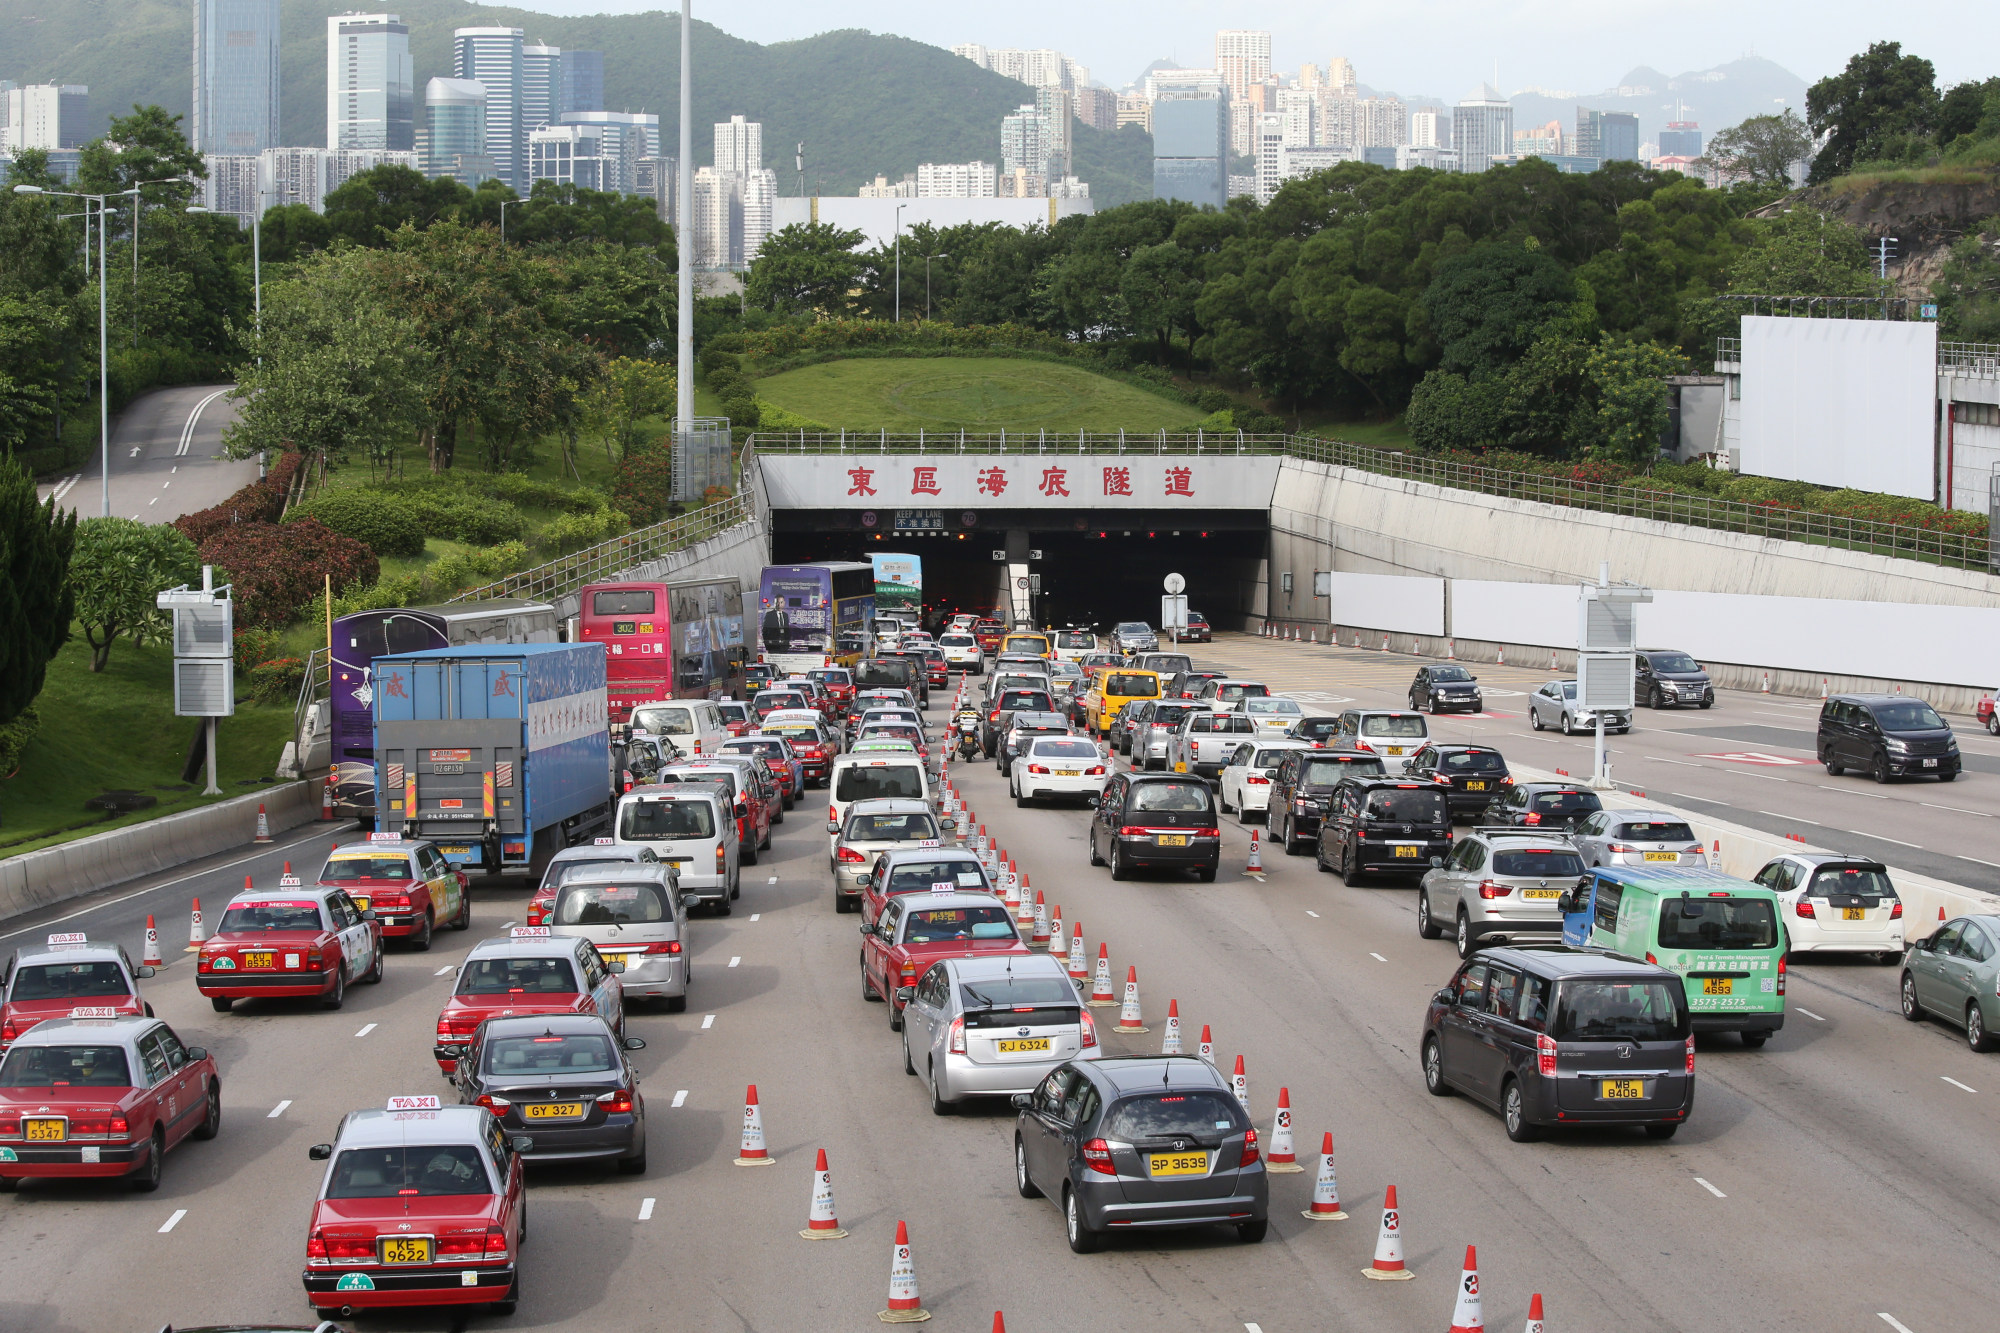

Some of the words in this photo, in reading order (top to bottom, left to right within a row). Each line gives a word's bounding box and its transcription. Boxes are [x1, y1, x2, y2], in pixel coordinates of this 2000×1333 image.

[848, 466, 1195, 497] 東區海底隧道
[864, 514, 876, 522] 70
[896, 510, 913, 518] KEEP
[916, 510, 924, 518] IN
[926, 510, 942, 518] LANE
[617, 624, 634, 633] 302
[1525, 891, 1537, 899] RP
[1538, 890, 1559, 898] 8397
[515, 927, 547, 935] TAXI
[51, 933, 84, 943] TAXI
[1668, 963, 1692, 971] BIOCYCLE
[1704, 986, 1731, 995] 4693
[1692, 998, 1746, 1006] 3575-2575
[78, 1007, 113, 1017] TAXI
[1000, 1042, 1015, 1051] RJ
[1019, 1040, 1048, 1050] 6324
[1615, 1080, 1630, 1088] MB
[1608, 1089, 1638, 1098] 8408
[392, 1097, 437, 1108] TAXI
[531, 1106, 546, 1116] GY
[552, 1104, 575, 1114] 327
[37, 1119, 50, 1129] PL
[30, 1128, 60, 1140] 5347
[1151, 1158, 1169, 1171] SP
[1172, 1156, 1206, 1169] 3639
[396, 1240, 415, 1250] KE
[388, 1250, 425, 1262] 9622
